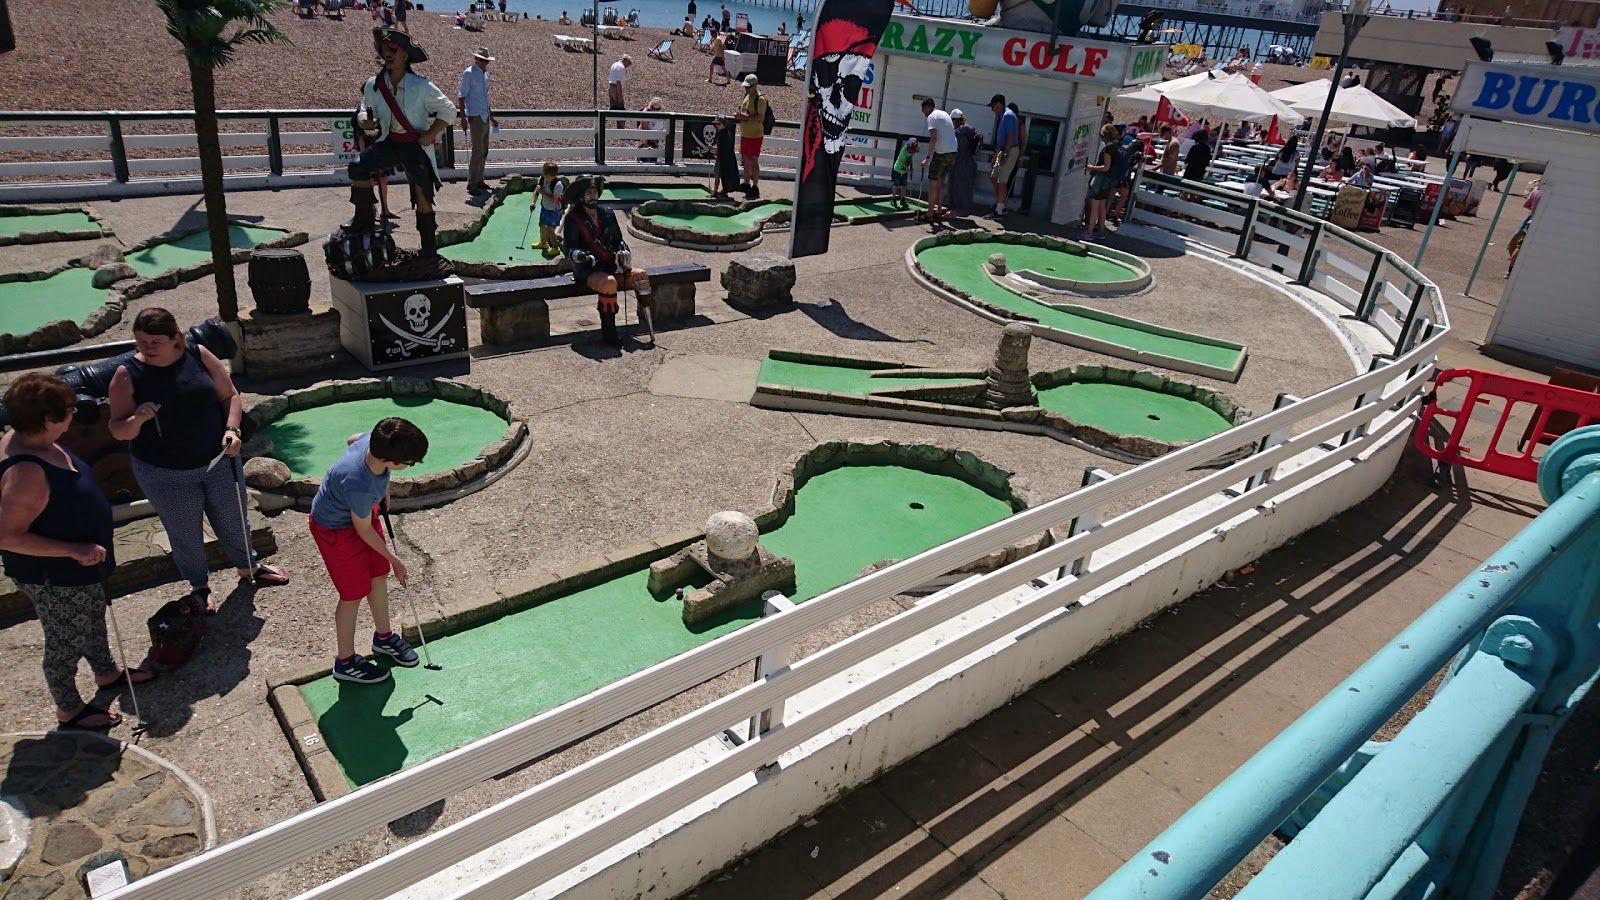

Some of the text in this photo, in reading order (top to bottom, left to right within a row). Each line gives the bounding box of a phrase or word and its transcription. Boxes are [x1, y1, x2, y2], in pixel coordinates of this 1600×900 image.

[1002, 37, 1108, 77] GOLF
[1132, 49, 1164, 80] GOLF
[1334, 206, 1360, 220] Coffee
[303, 732, 320, 746] 16
